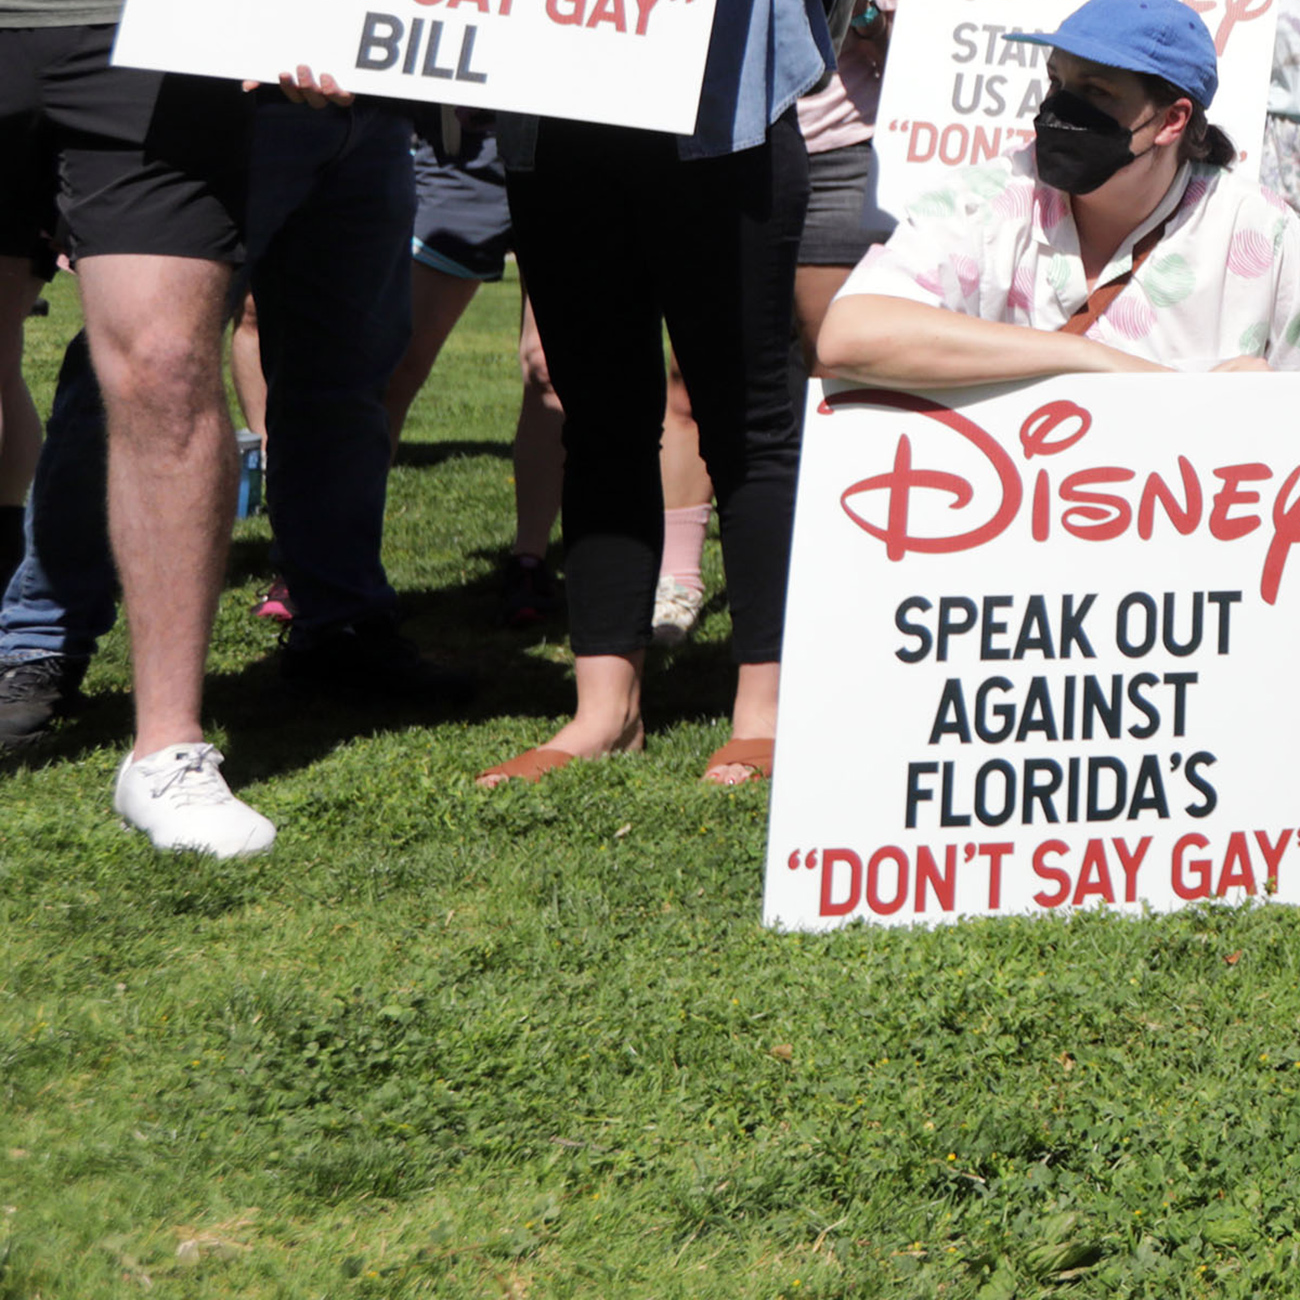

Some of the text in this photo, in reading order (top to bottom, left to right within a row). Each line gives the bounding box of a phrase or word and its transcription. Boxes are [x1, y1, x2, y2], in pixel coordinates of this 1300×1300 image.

[355, 12, 487, 84] BILL
[952, 73, 1008, 118] US
[894, 590, 1243, 663] SPEAK OUT
[928, 671, 1198, 745] AGAINST
[905, 751, 1219, 829] FLORIDA'S
[787, 842, 1014, 917] "DON'T
[1032, 836, 1154, 908] SAY
